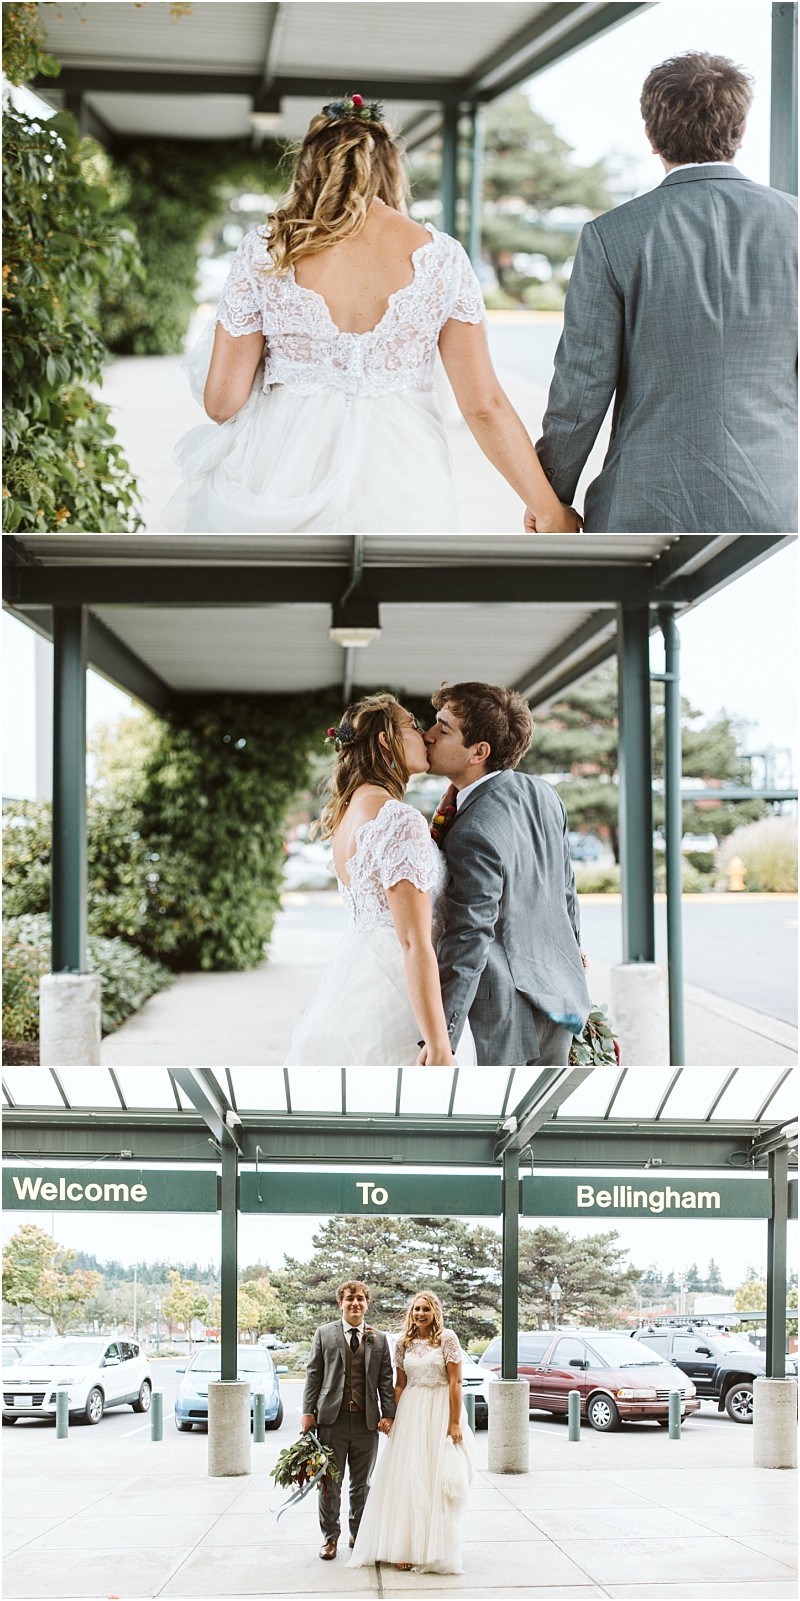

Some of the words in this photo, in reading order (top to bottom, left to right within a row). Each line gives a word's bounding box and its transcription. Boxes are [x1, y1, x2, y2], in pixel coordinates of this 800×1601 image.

[12, 1177, 148, 1203] Welcome
[356, 1182, 389, 1205] To
[576, 1185, 721, 1213] Bellingham
